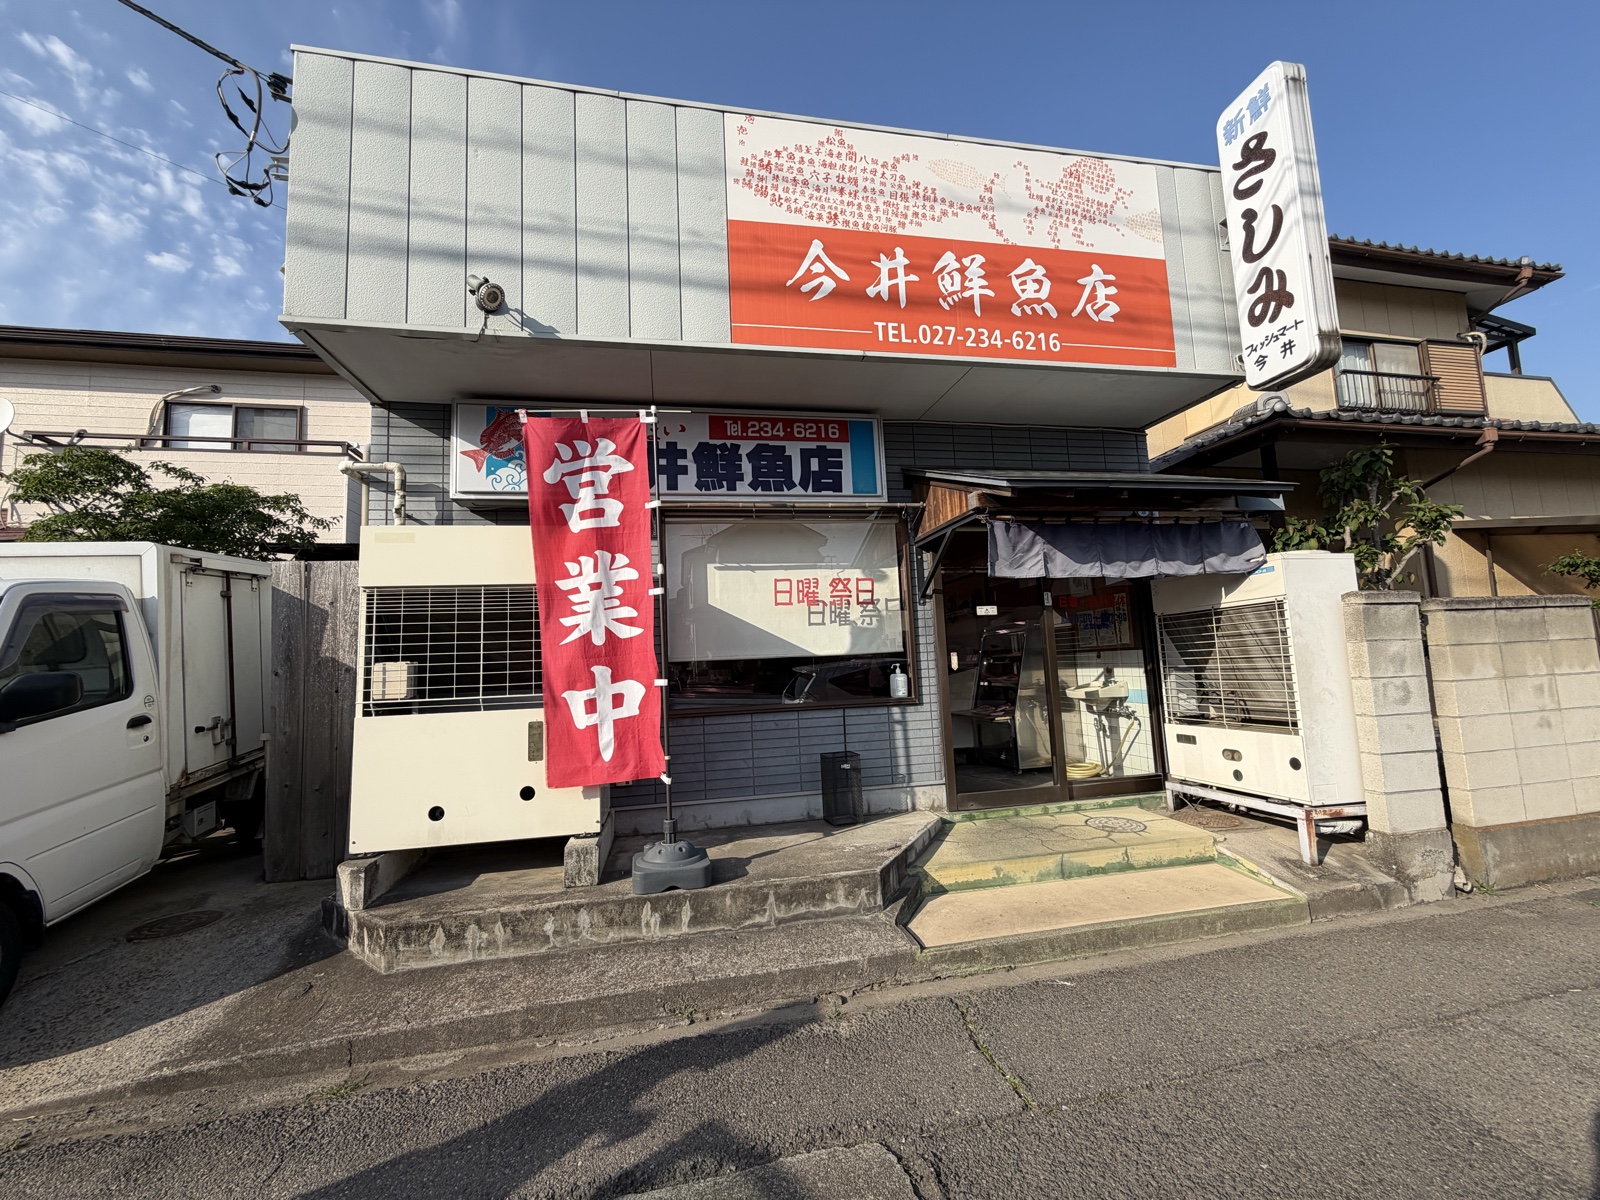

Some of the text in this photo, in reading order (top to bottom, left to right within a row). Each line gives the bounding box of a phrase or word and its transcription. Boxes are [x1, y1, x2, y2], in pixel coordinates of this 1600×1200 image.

[1222, 82, 1272, 146] 新鮮
[1232, 131, 1295, 328] さしみ
[786, 239, 1121, 322] 今井鮮魚店
[873, 321, 1061, 353] TEL.027-234-6216
[1245, 319, 1304, 357] フィッシュマート
[1254, 338, 1296, 371] 今井
[543, 438, 647, 763] 営業中
[774, 577, 875, 607] 日曜、祭日
